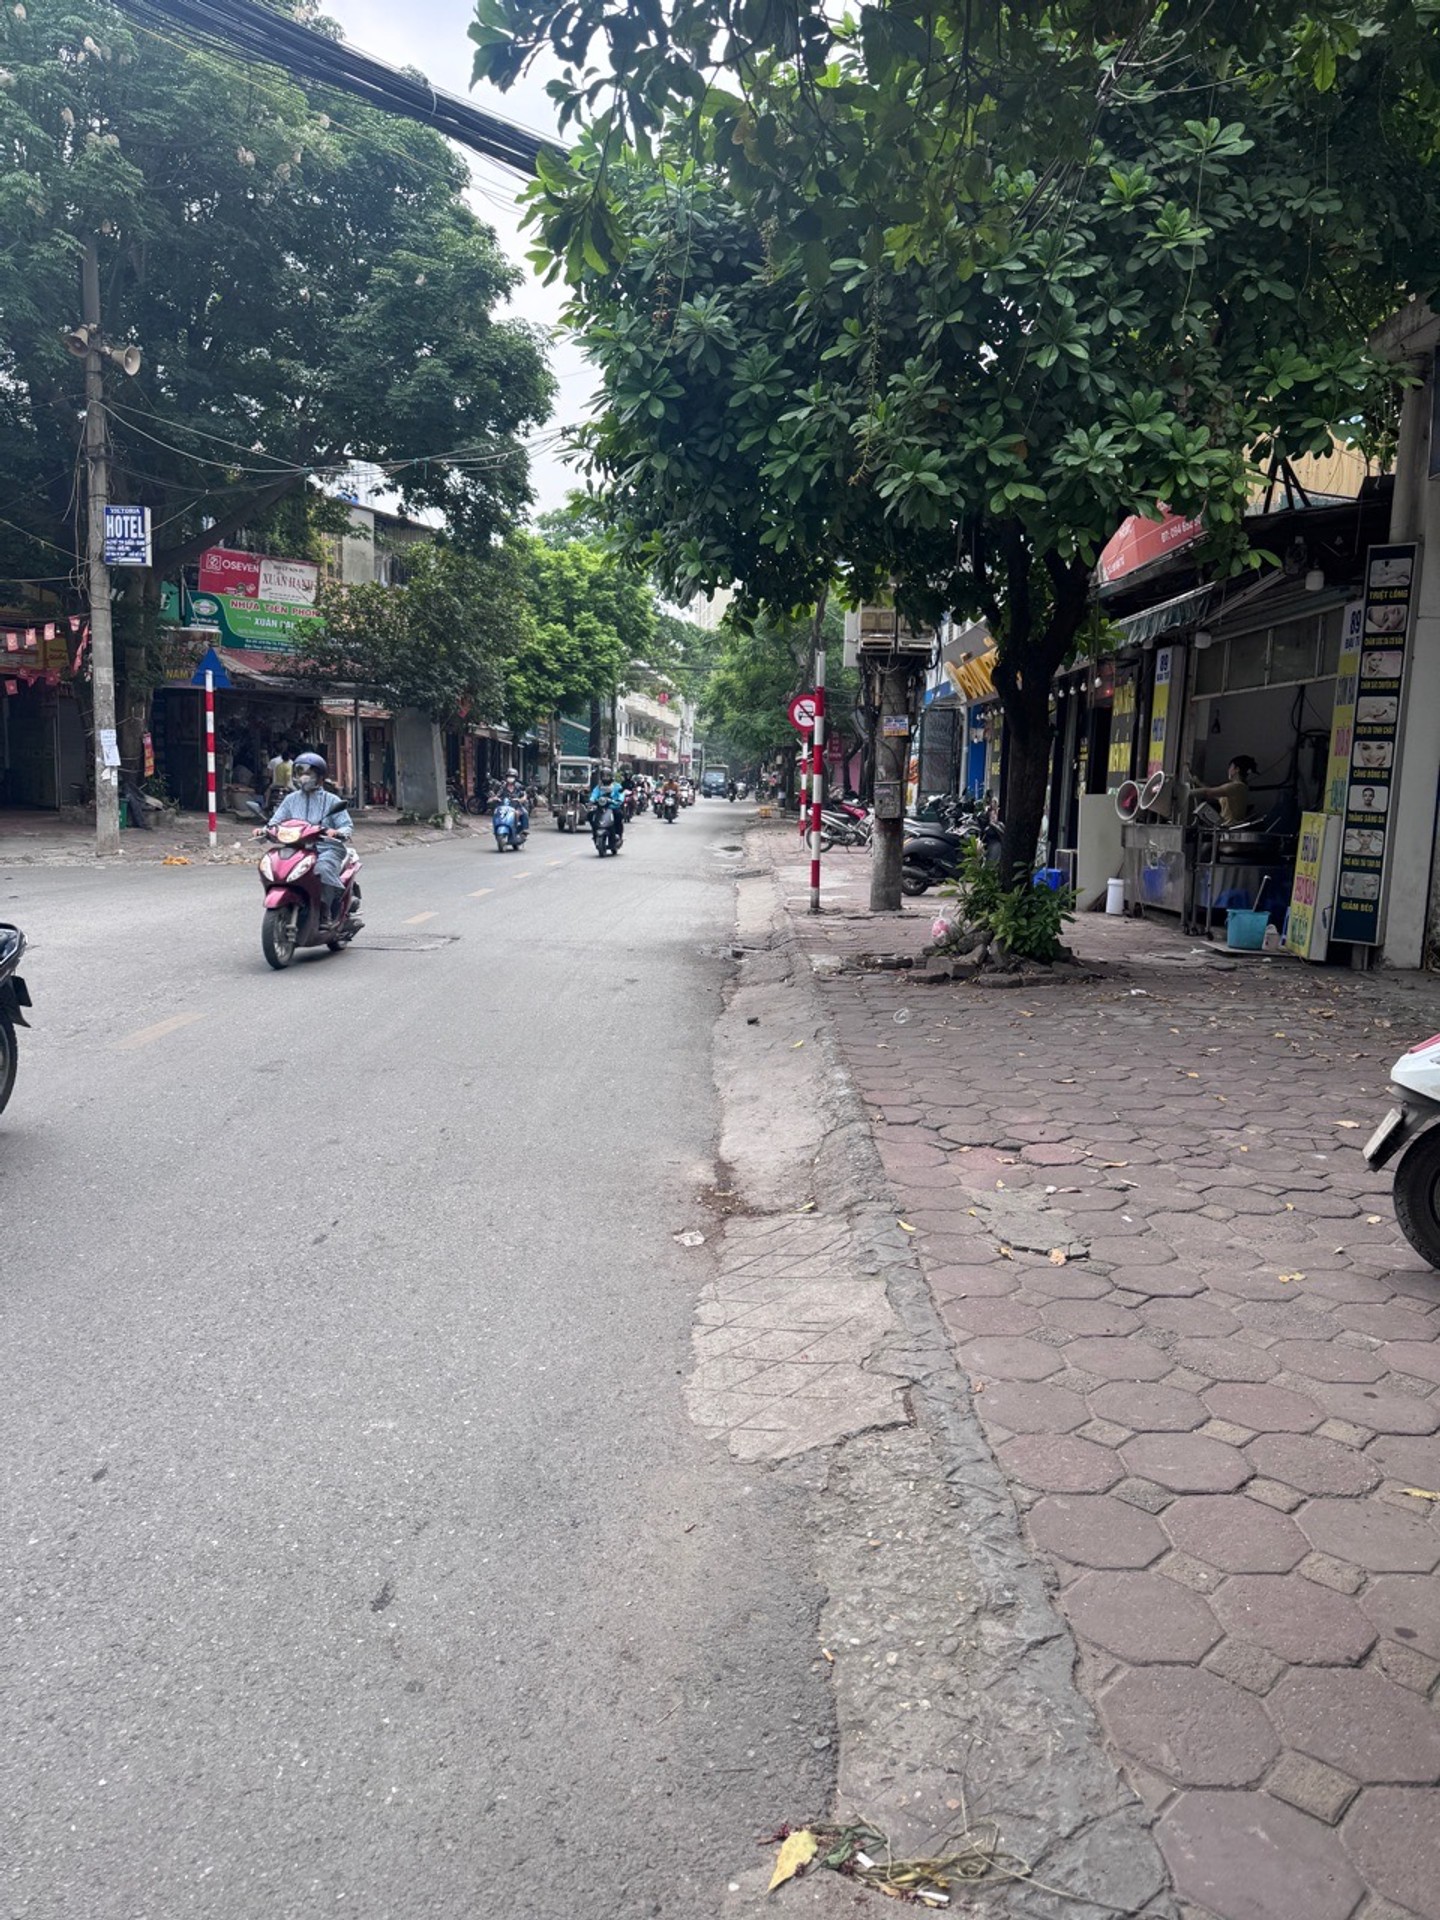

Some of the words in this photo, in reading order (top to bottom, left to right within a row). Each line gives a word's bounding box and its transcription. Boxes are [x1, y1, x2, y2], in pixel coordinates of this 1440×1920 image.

[106, 515, 145, 538] HOTEL
[222, 559, 259, 573] OSEVEN
[230, 599, 260, 612] NHỰA
[292, 607, 321, 618] PHON
[1350, 609, 1362, 635] 89
